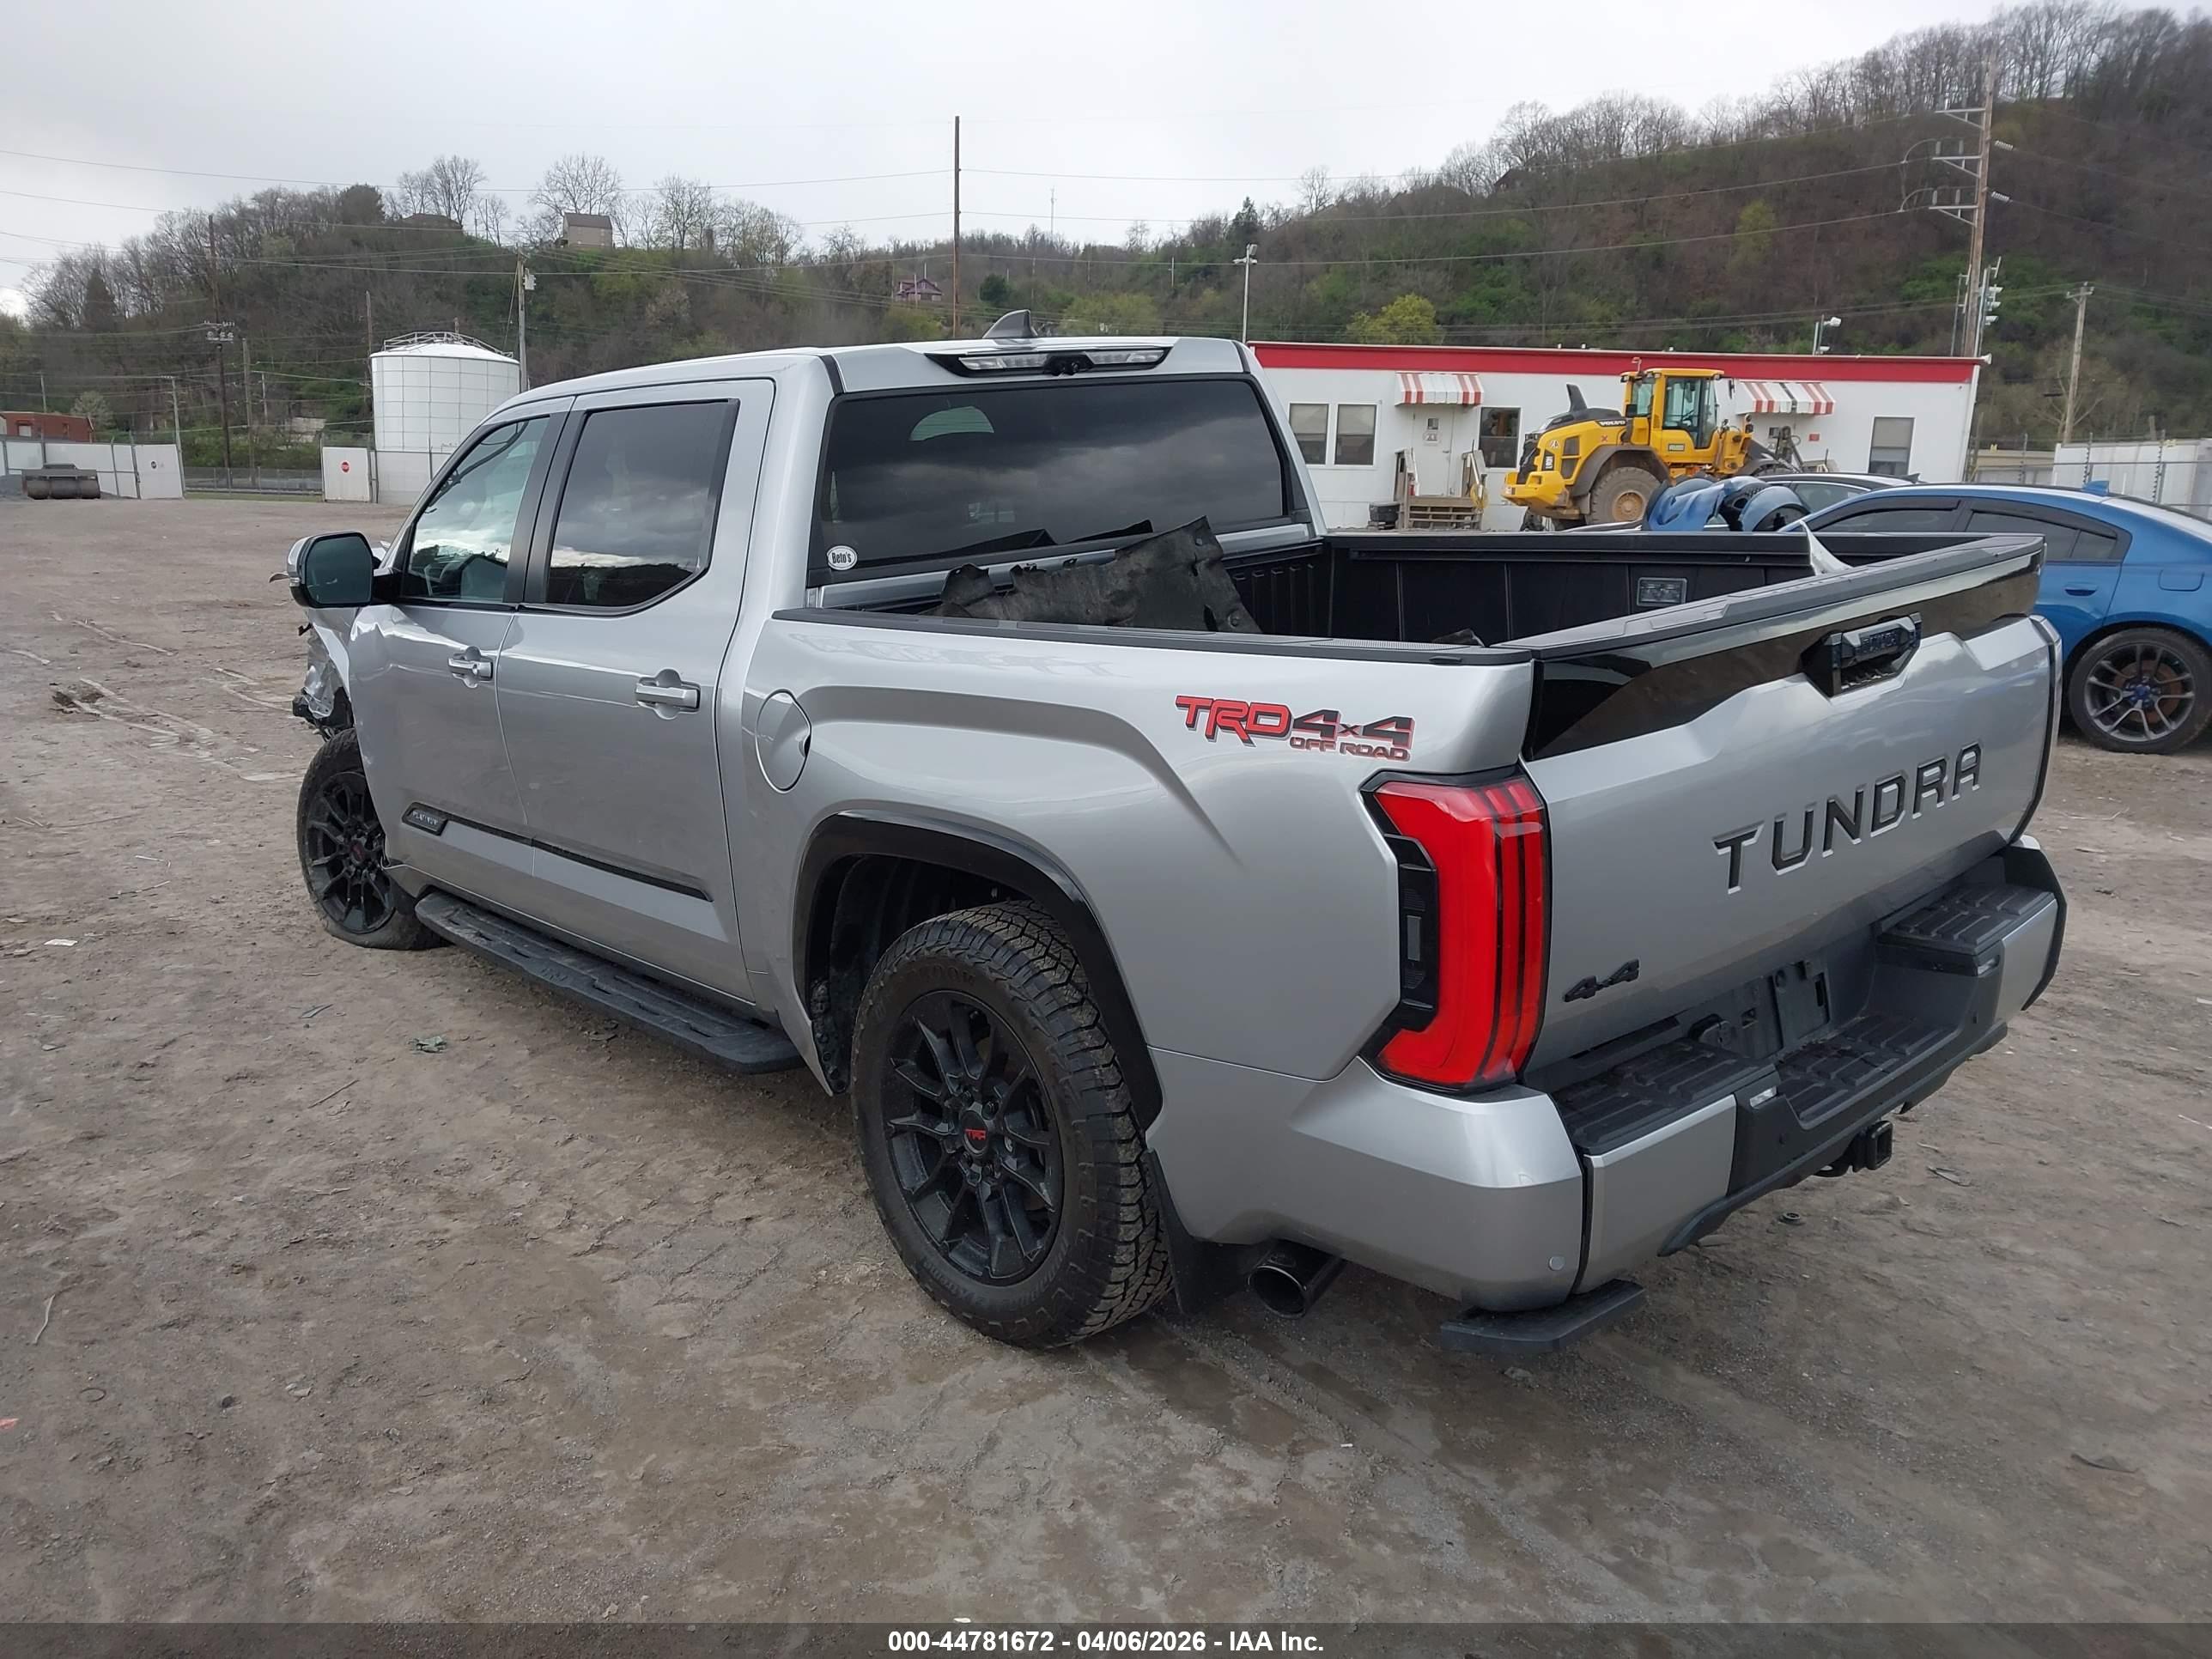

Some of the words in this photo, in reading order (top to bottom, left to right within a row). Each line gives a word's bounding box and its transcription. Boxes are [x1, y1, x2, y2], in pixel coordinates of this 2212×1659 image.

[831, 551, 852, 564] Beto's
[1176, 696, 1291, 747] TRD
[1293, 710, 1415, 749] 4x4
[1290, 737, 1337, 752] OFF
[1339, 742, 1411, 762] ROAD
[1711, 741, 1983, 894] TUNDRA
